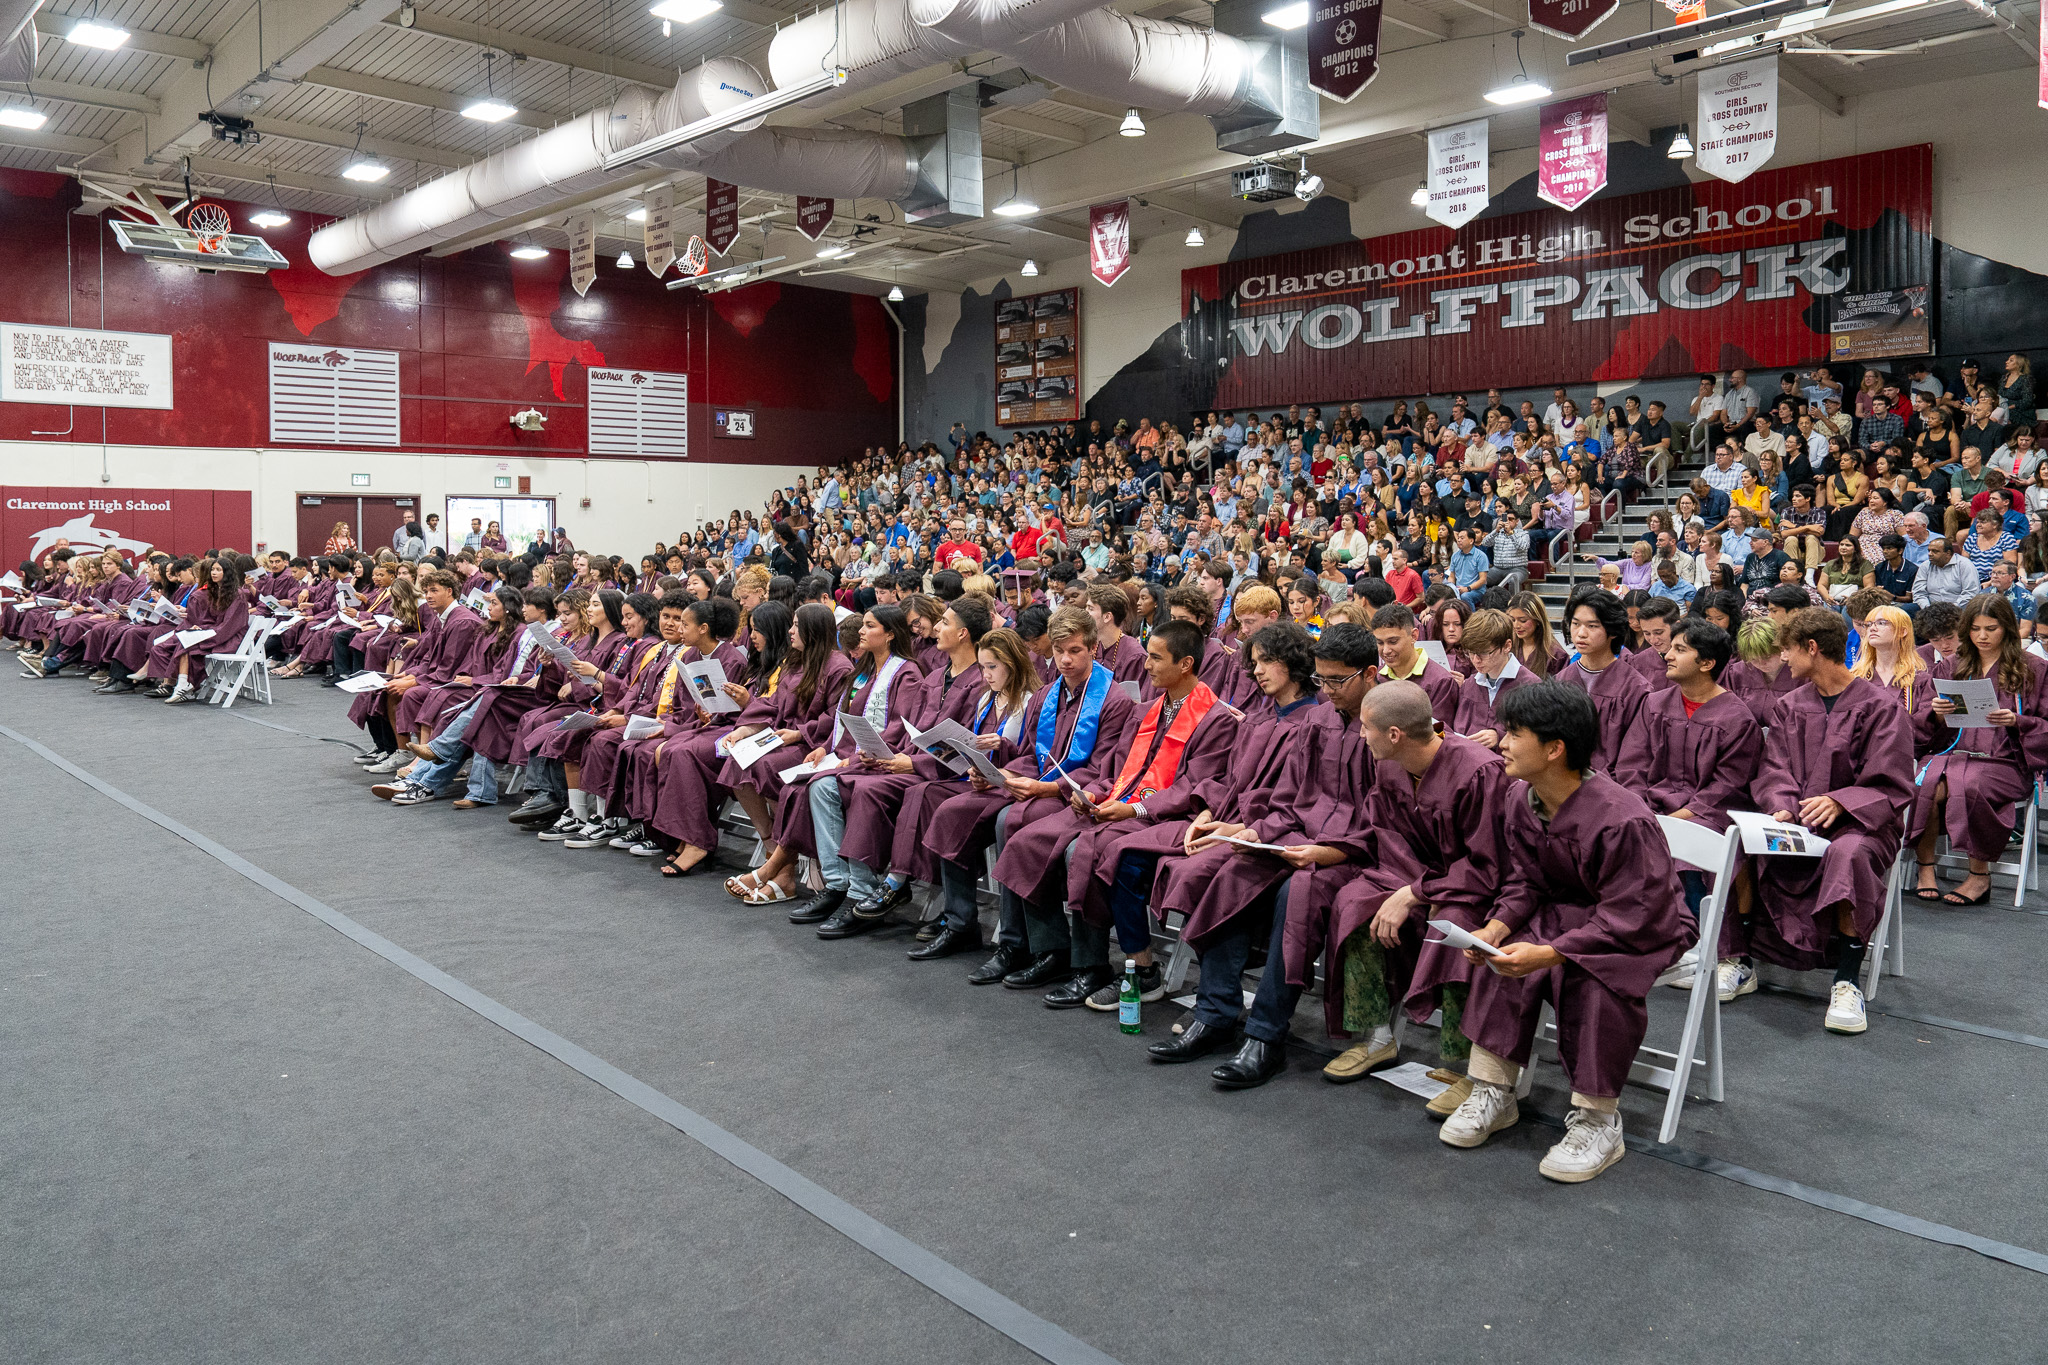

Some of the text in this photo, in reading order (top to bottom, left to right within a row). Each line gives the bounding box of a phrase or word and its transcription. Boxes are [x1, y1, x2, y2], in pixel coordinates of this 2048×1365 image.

[1316, 5, 1340, 22] GIRLS
[1562, 0, 1590, 15] 2011
[1321, 44, 1374, 68] CHAMPIONS
[1334, 62, 1358, 78] 2012
[1714, 82, 1762, 96] SOUTHERN SECTION
[1726, 96, 1748, 108] GIRLS
[1734, 103, 1768, 117] COUNTRY
[1554, 126, 1576, 134] SOUTHERN
[1562, 135, 1584, 147] GIRLS
[1701, 130, 1774, 150] STATE CHAMPIONS
[1449, 154, 1466, 164] GIRLS
[1545, 143, 1602, 161] CROSS COUNTRY
[1726, 152, 1748, 164] 2017
[1436, 160, 1480, 176] CROSS COUNTRY
[1551, 168, 1596, 184] CHAMPIONS
[1430, 184, 1486, 200] STATE CHAMPIONS
[1563, 182, 1584, 194] 2018
[802, 202, 826, 216] CHAMPIONS
[1450, 203, 1466, 214] 2018
[808, 214, 820, 224] 2014
[1240, 186, 1838, 300] Claremont High School
[1230, 237, 1850, 357] WOLFPACK
[1838, 304, 1900, 322] BASKETBALL
[32, 341, 58, 349] HEARTS
[46, 335, 65, 343] THEE
[72, 337, 97, 345] ALMA
[31, 347, 62, 355] LOYALTY
[36, 354, 76, 362] SPLENDOR
[79, 386, 124, 394] CLAREMONT
[734, 422, 744, 431] 24
[353, 475, 368, 485] EXIT
[6, 498, 171, 514] Claremont High School
